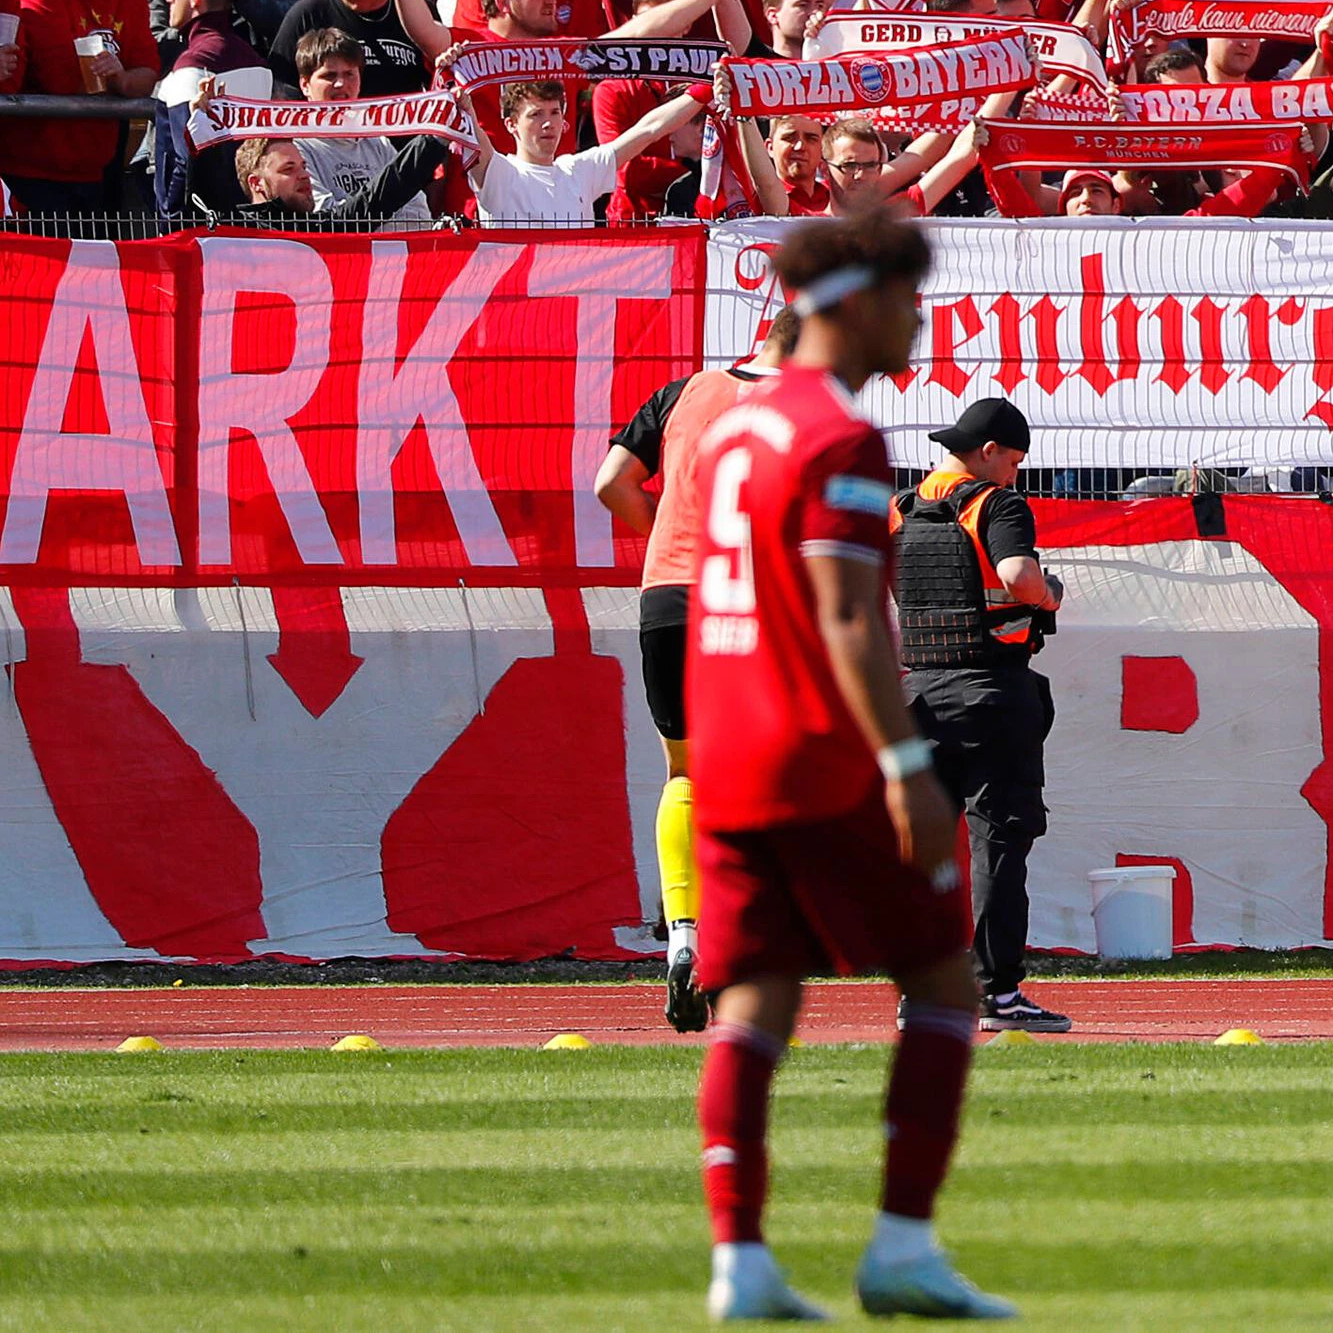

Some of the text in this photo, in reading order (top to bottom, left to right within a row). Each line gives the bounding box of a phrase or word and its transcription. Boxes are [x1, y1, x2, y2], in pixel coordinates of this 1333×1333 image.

[860, 23, 922, 44] GERD
[1199, 1, 1246, 33] kann
[610, 47, 647, 69] ST
[733, 59, 855, 109] FORZA
[887, 34, 1033, 99] BAYERN
[206, 94, 347, 133] SÜDKURVE
[1133, 86, 1262, 123] FORZA
[2, 237, 676, 568] ARKT
